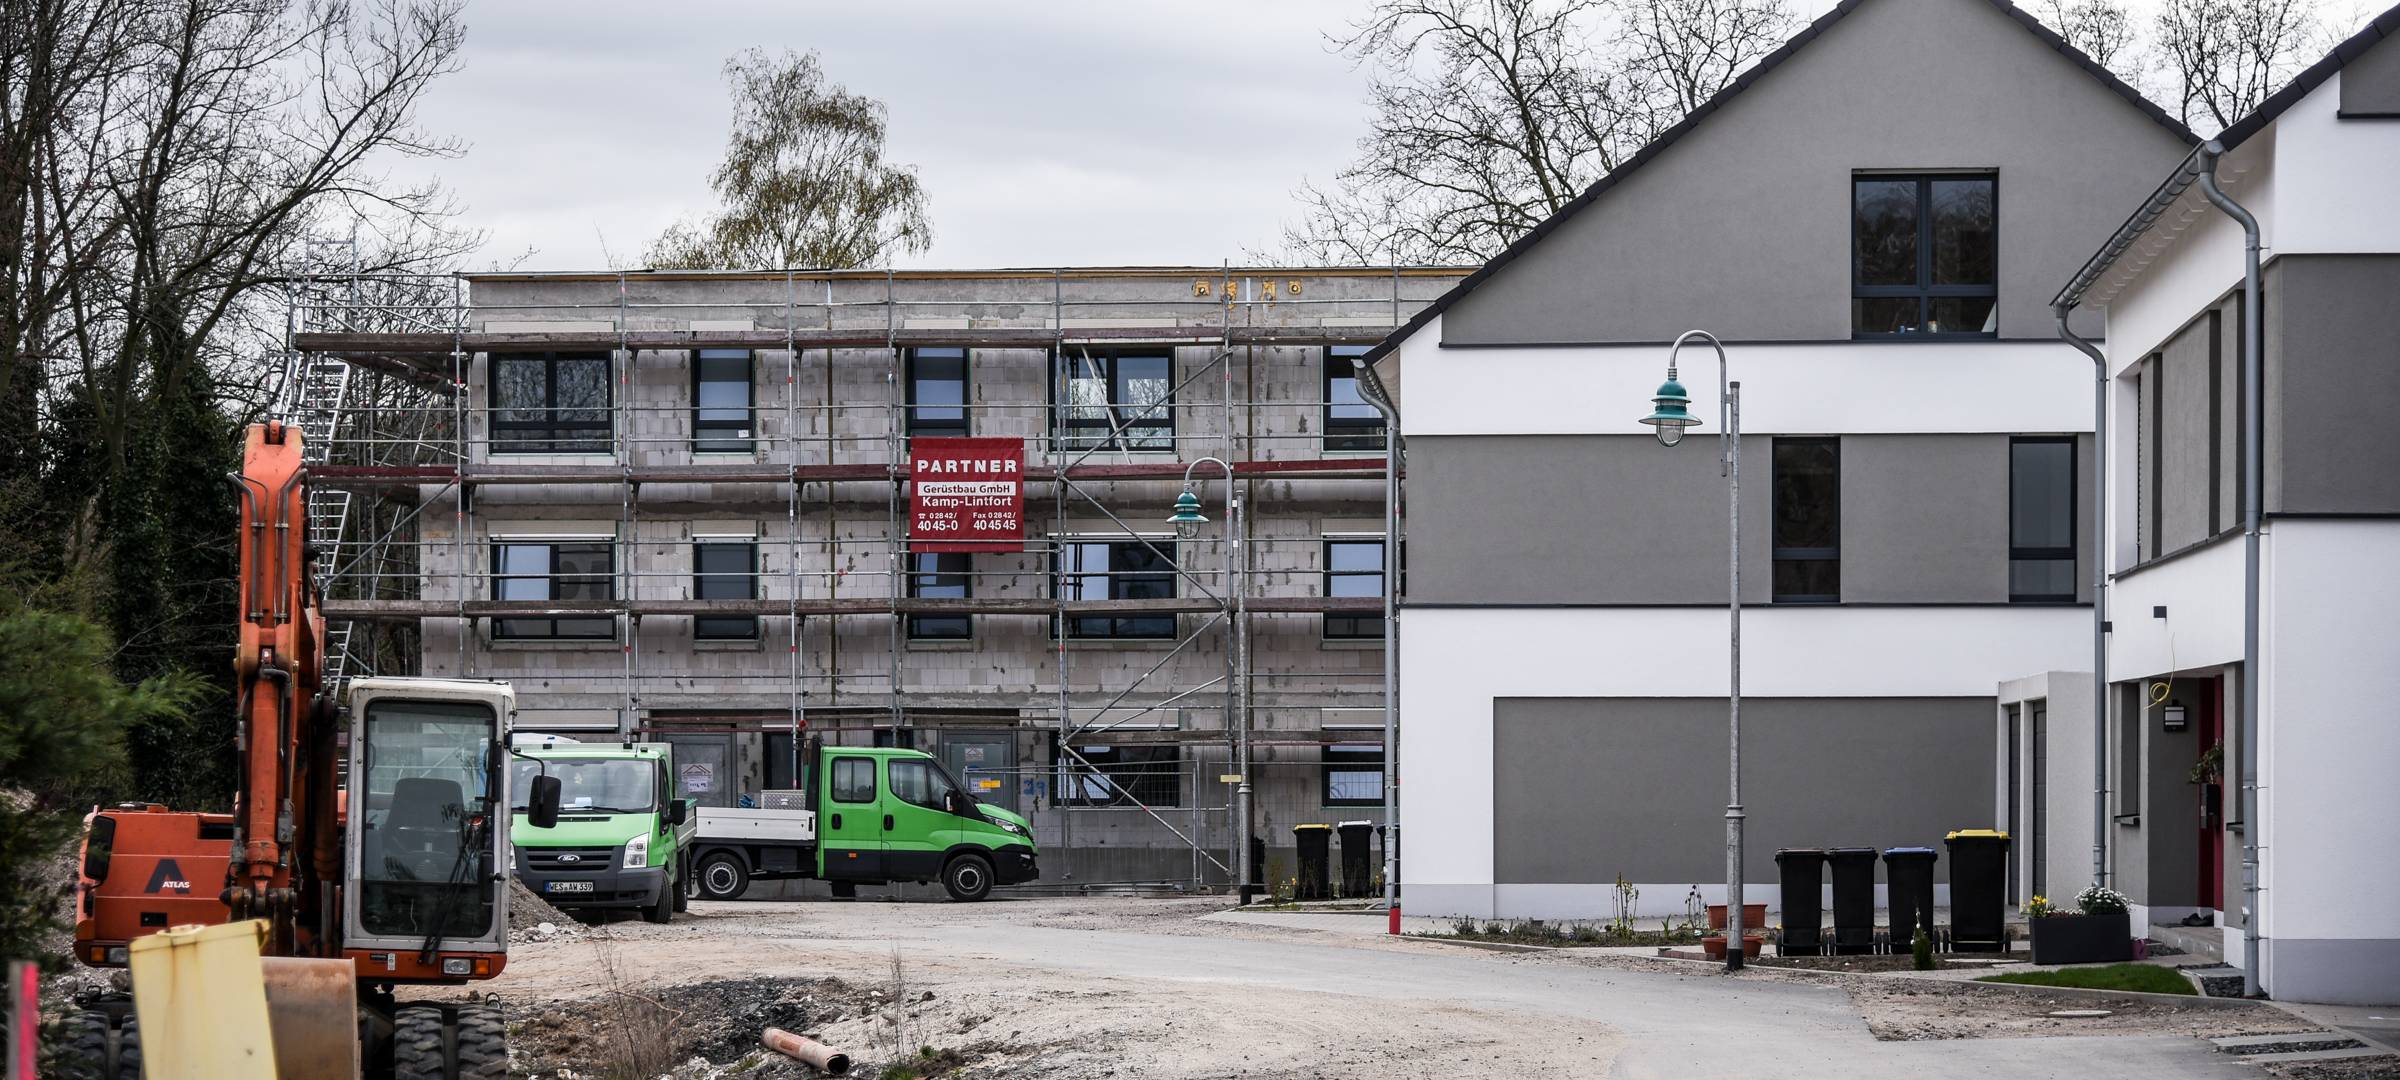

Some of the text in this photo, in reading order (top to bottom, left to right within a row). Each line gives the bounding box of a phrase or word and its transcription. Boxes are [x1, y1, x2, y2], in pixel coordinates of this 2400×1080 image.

[917, 460, 1017, 473] PARTNER
[923, 484, 1010, 493] Gerüstbau GmbH
[922, 496, 1012, 508] Kamp-Lintfort
